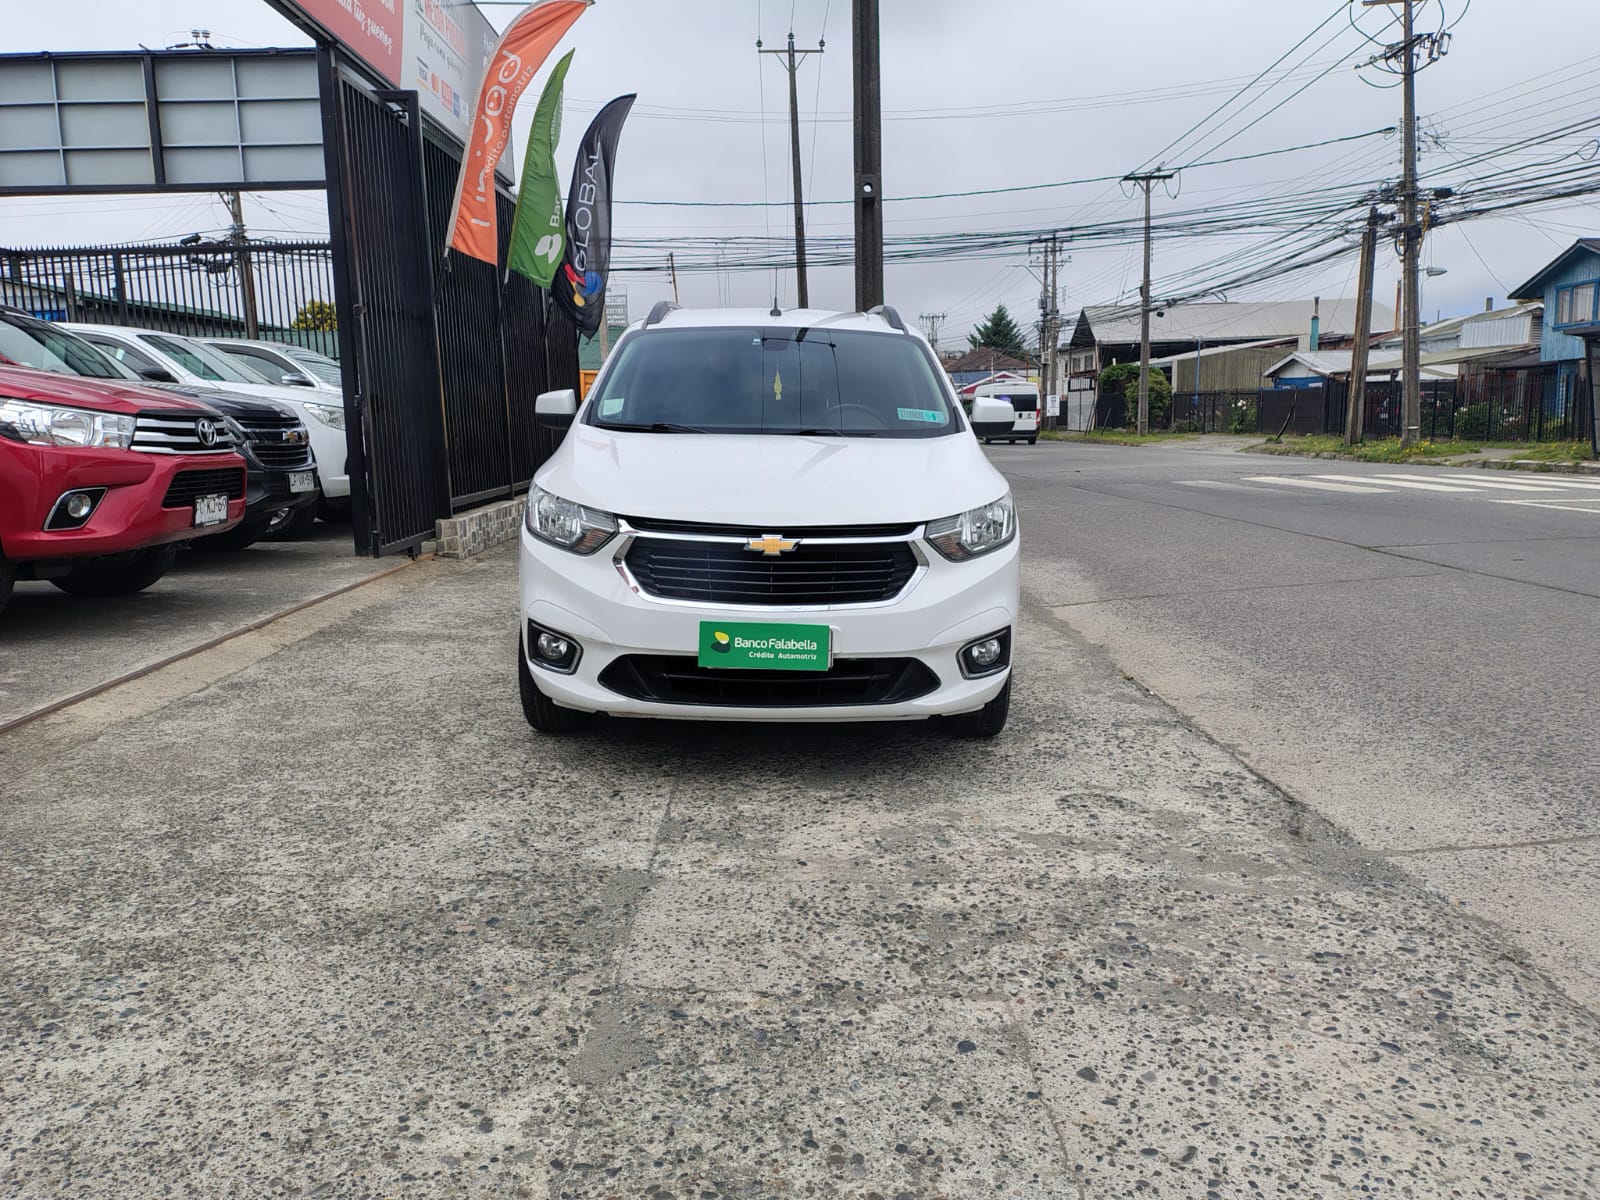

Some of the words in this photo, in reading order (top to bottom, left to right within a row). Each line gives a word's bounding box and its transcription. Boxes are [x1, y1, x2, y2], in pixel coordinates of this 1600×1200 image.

[502, 65, 533, 138] automotriz
[575, 141, 600, 271] GLOBAL
[734, 637, 767, 649] Banco
[769, 638, 817, 650] Falabella
[749, 651, 774, 659] Crédito
[778, 652, 817, 660] Automotriz
